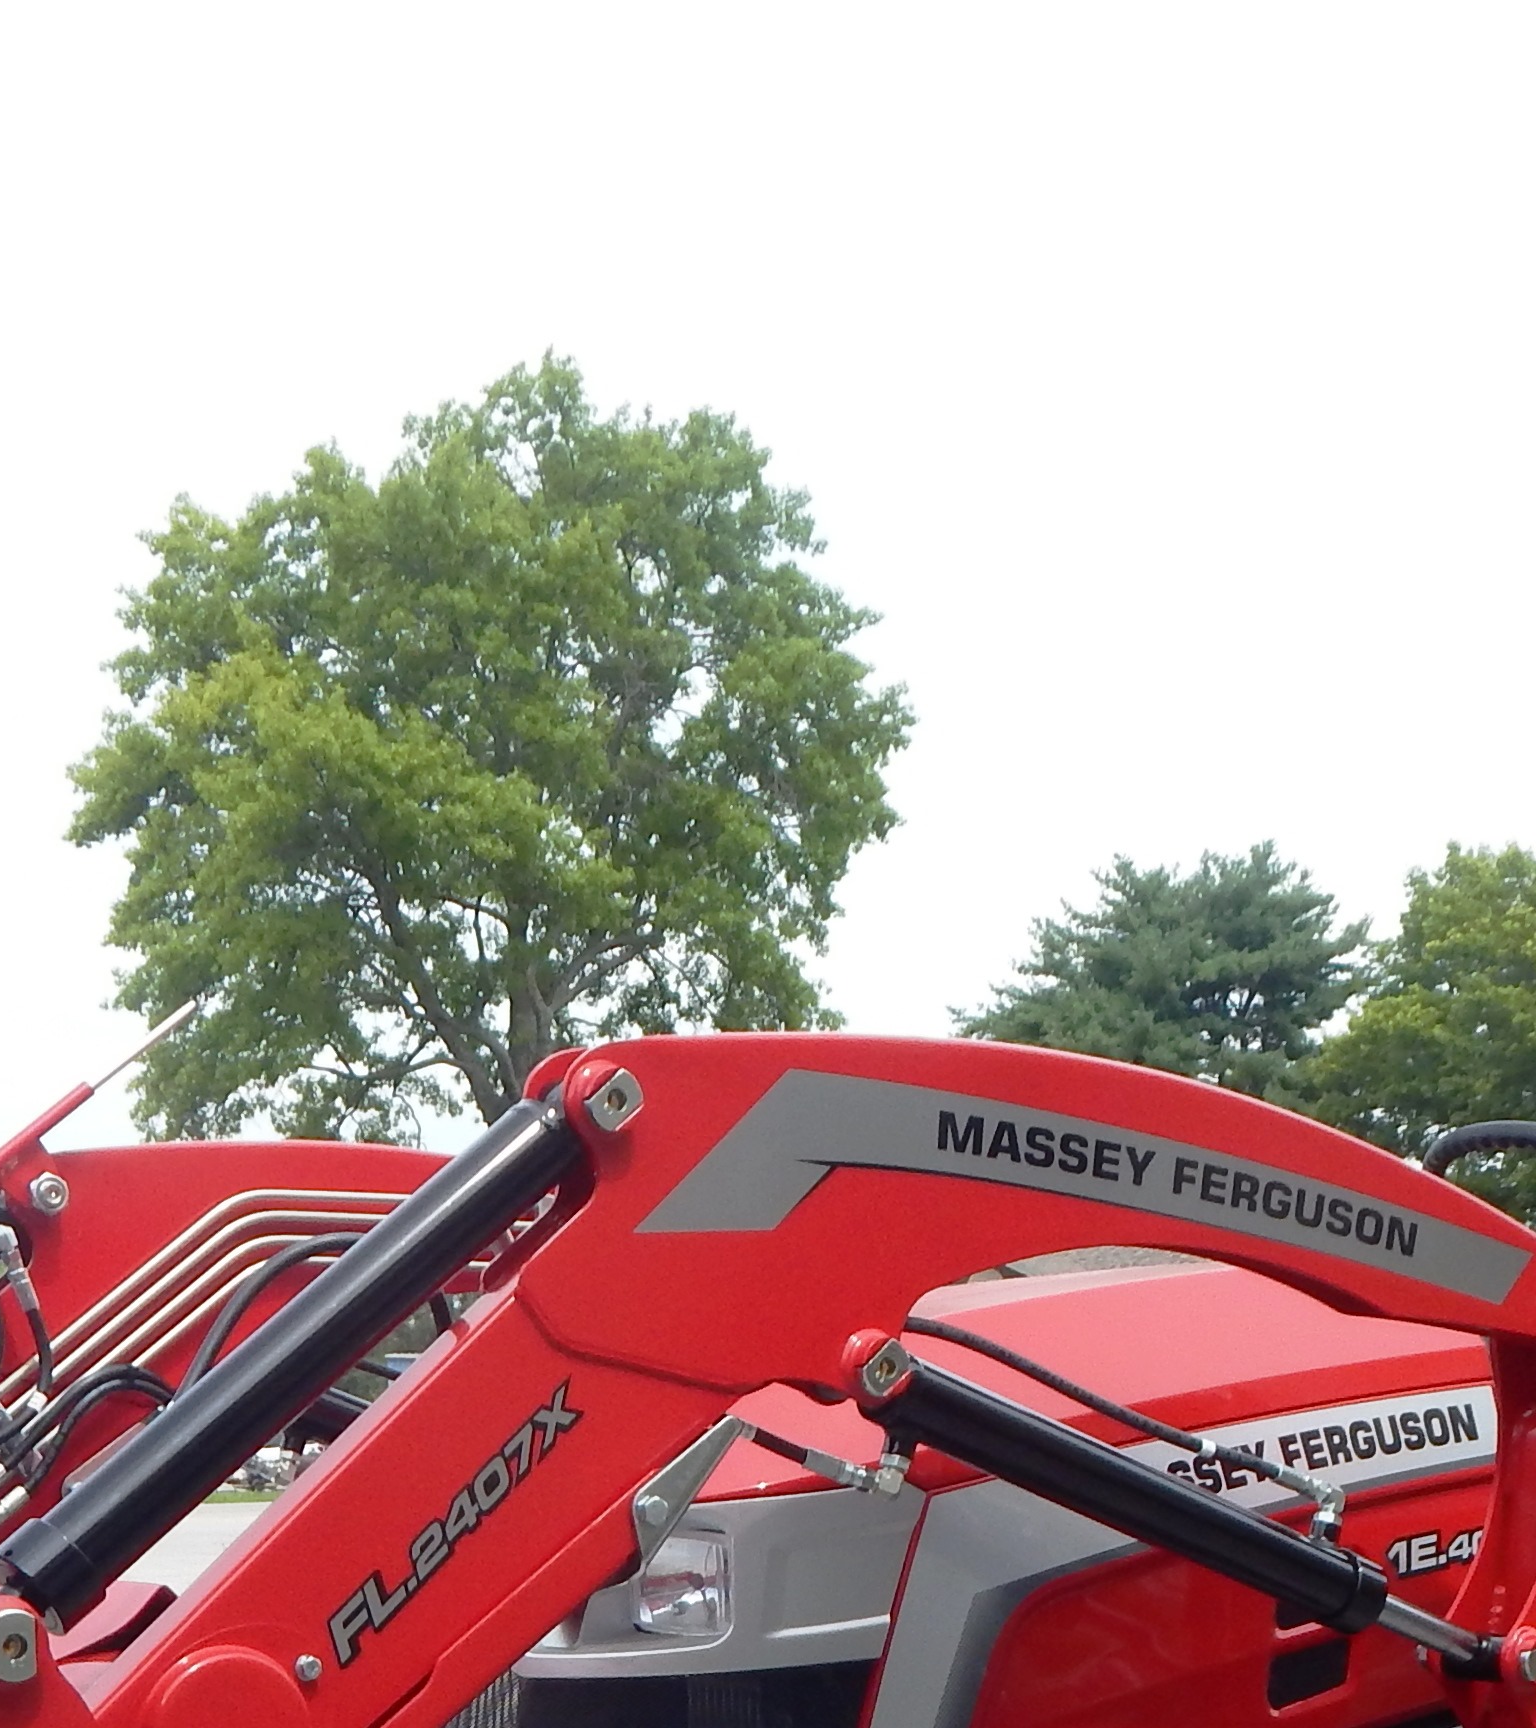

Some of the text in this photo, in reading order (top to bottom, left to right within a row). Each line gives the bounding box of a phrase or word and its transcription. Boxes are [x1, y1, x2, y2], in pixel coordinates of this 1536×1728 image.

[937, 1110, 1420, 1258] MASSEY FERGUSON
[1277, 1403, 1480, 1472] FERGUSON
[328, 1375, 583, 1668] FL.2407X
